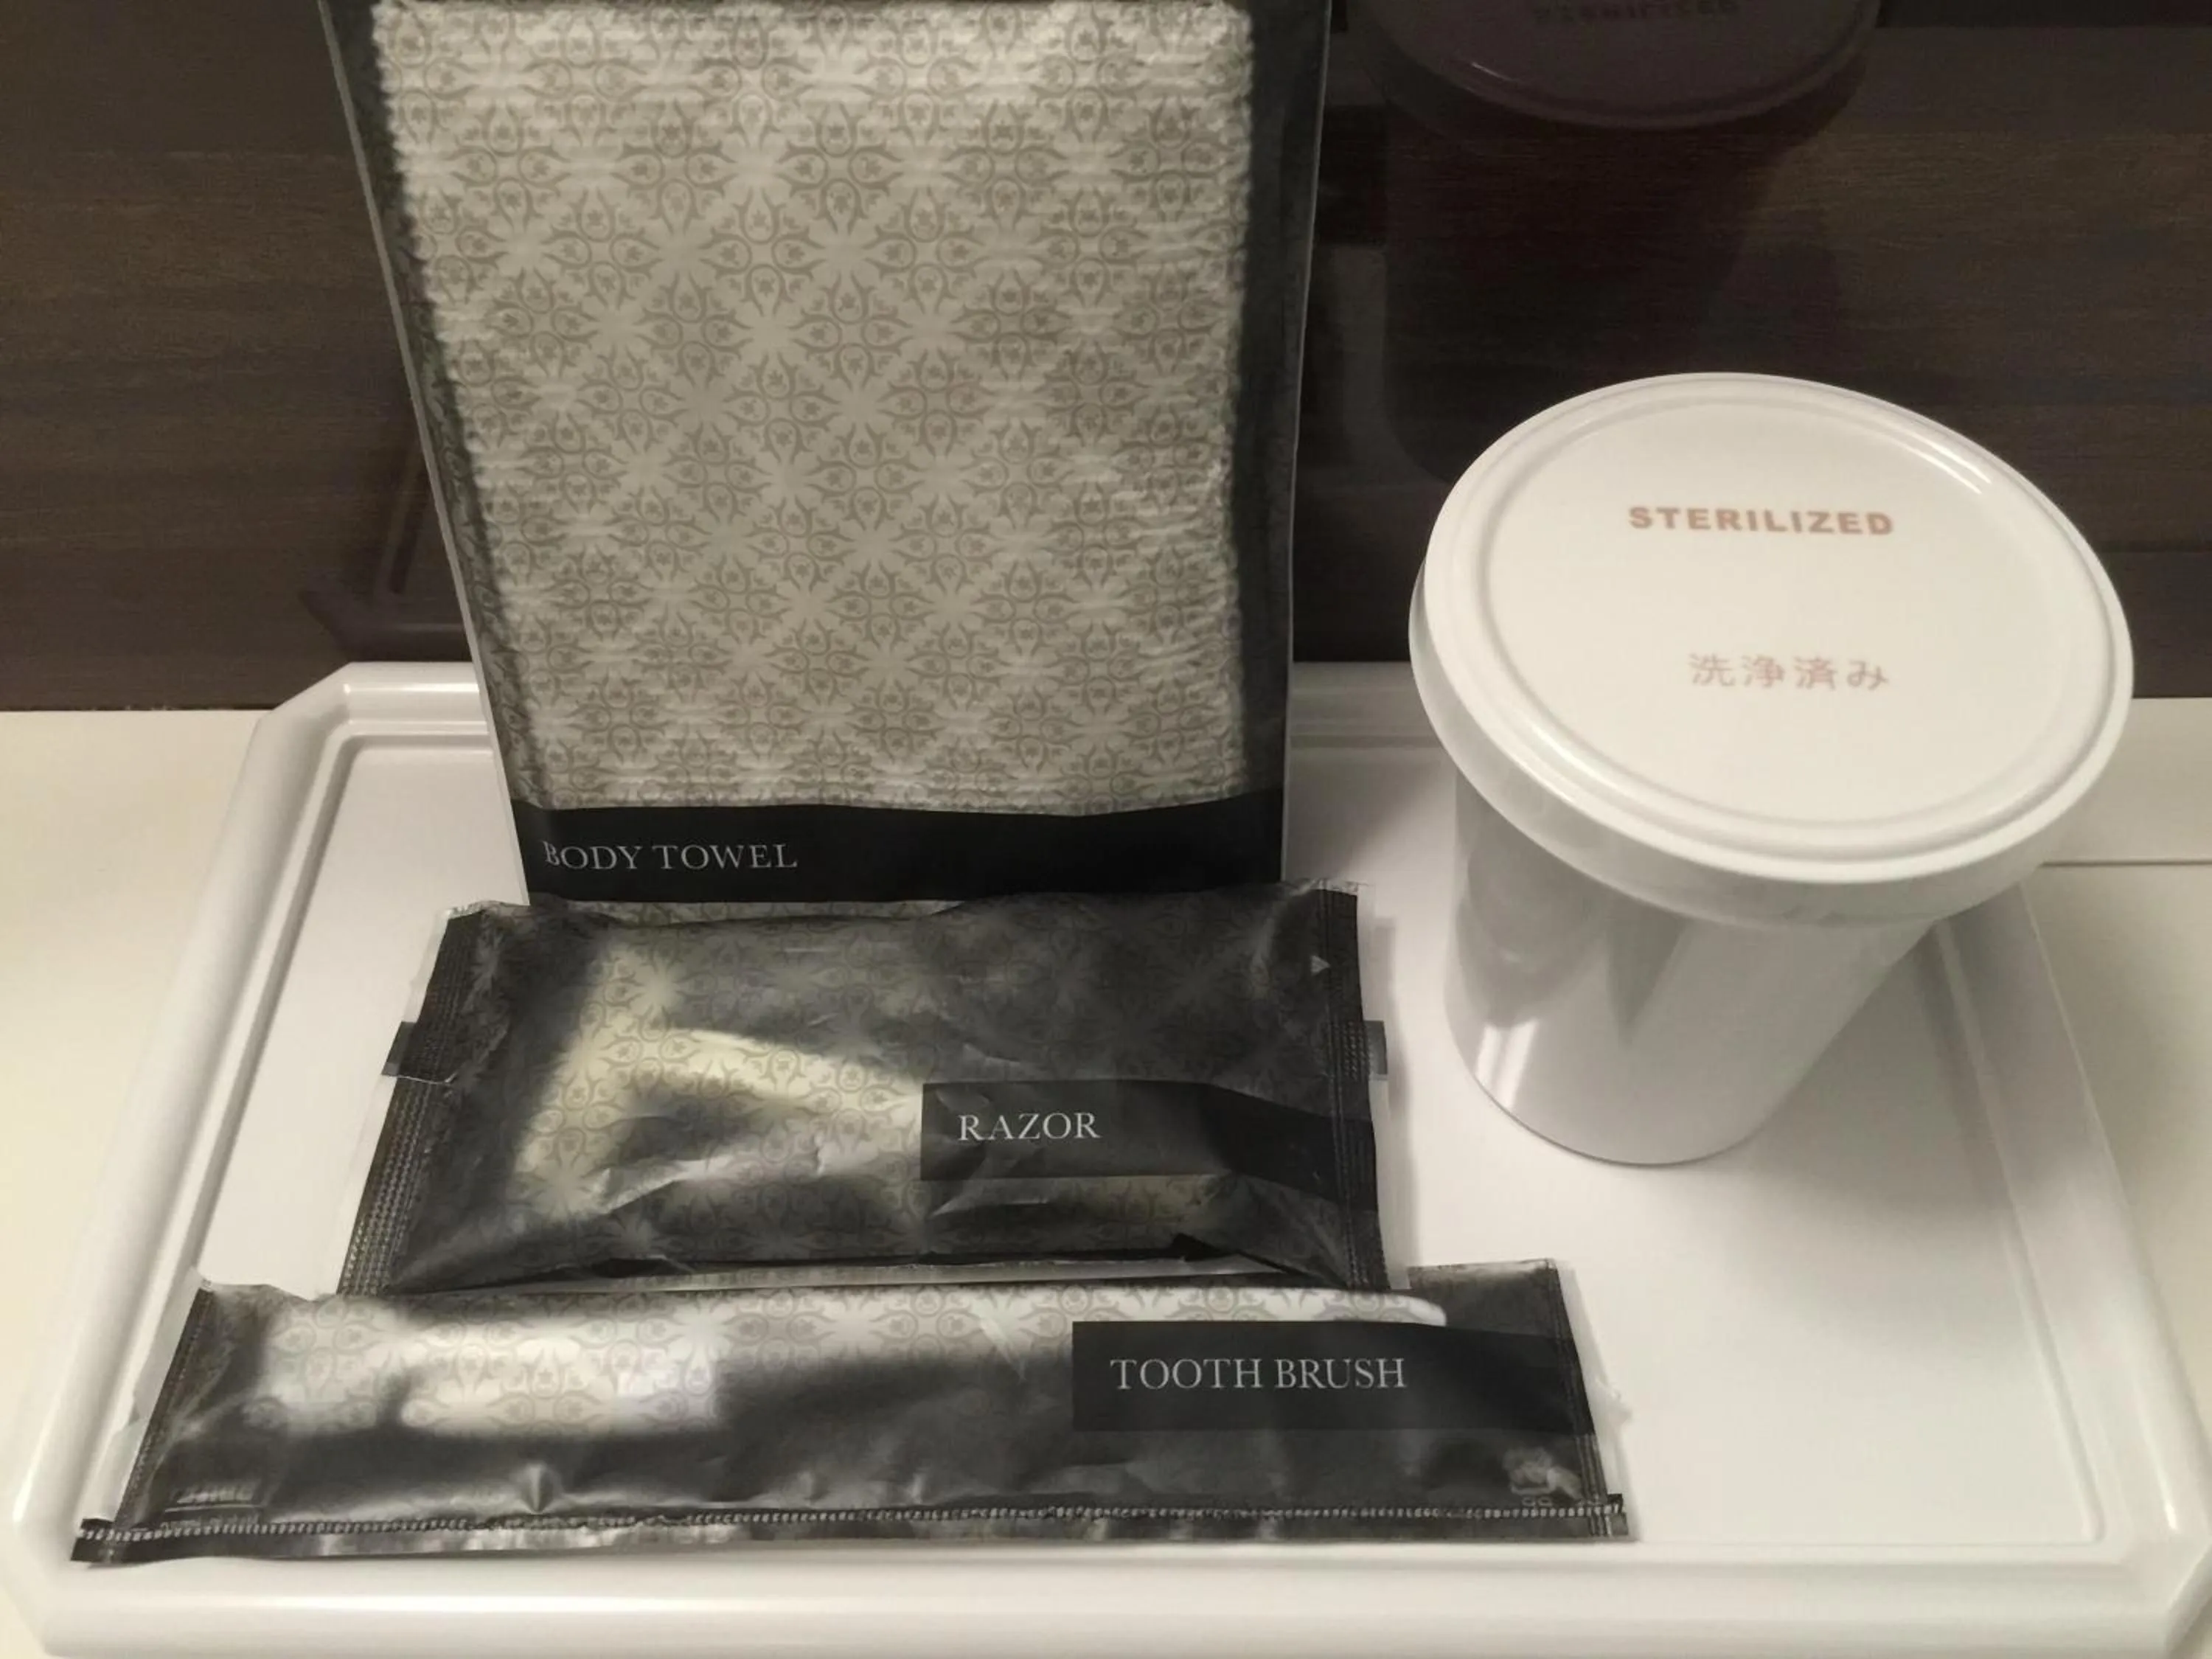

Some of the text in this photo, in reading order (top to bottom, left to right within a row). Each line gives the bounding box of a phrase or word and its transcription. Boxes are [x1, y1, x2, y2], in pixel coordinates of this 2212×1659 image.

[1628, 506, 1894, 535] STERILIZED
[1688, 653, 1890, 691] 洗浄済み
[542, 841, 799, 870] BODY TOWEL
[958, 1111, 1103, 1141] RAZOR
[1109, 1357, 1408, 1390] TOOTH BRUSH
